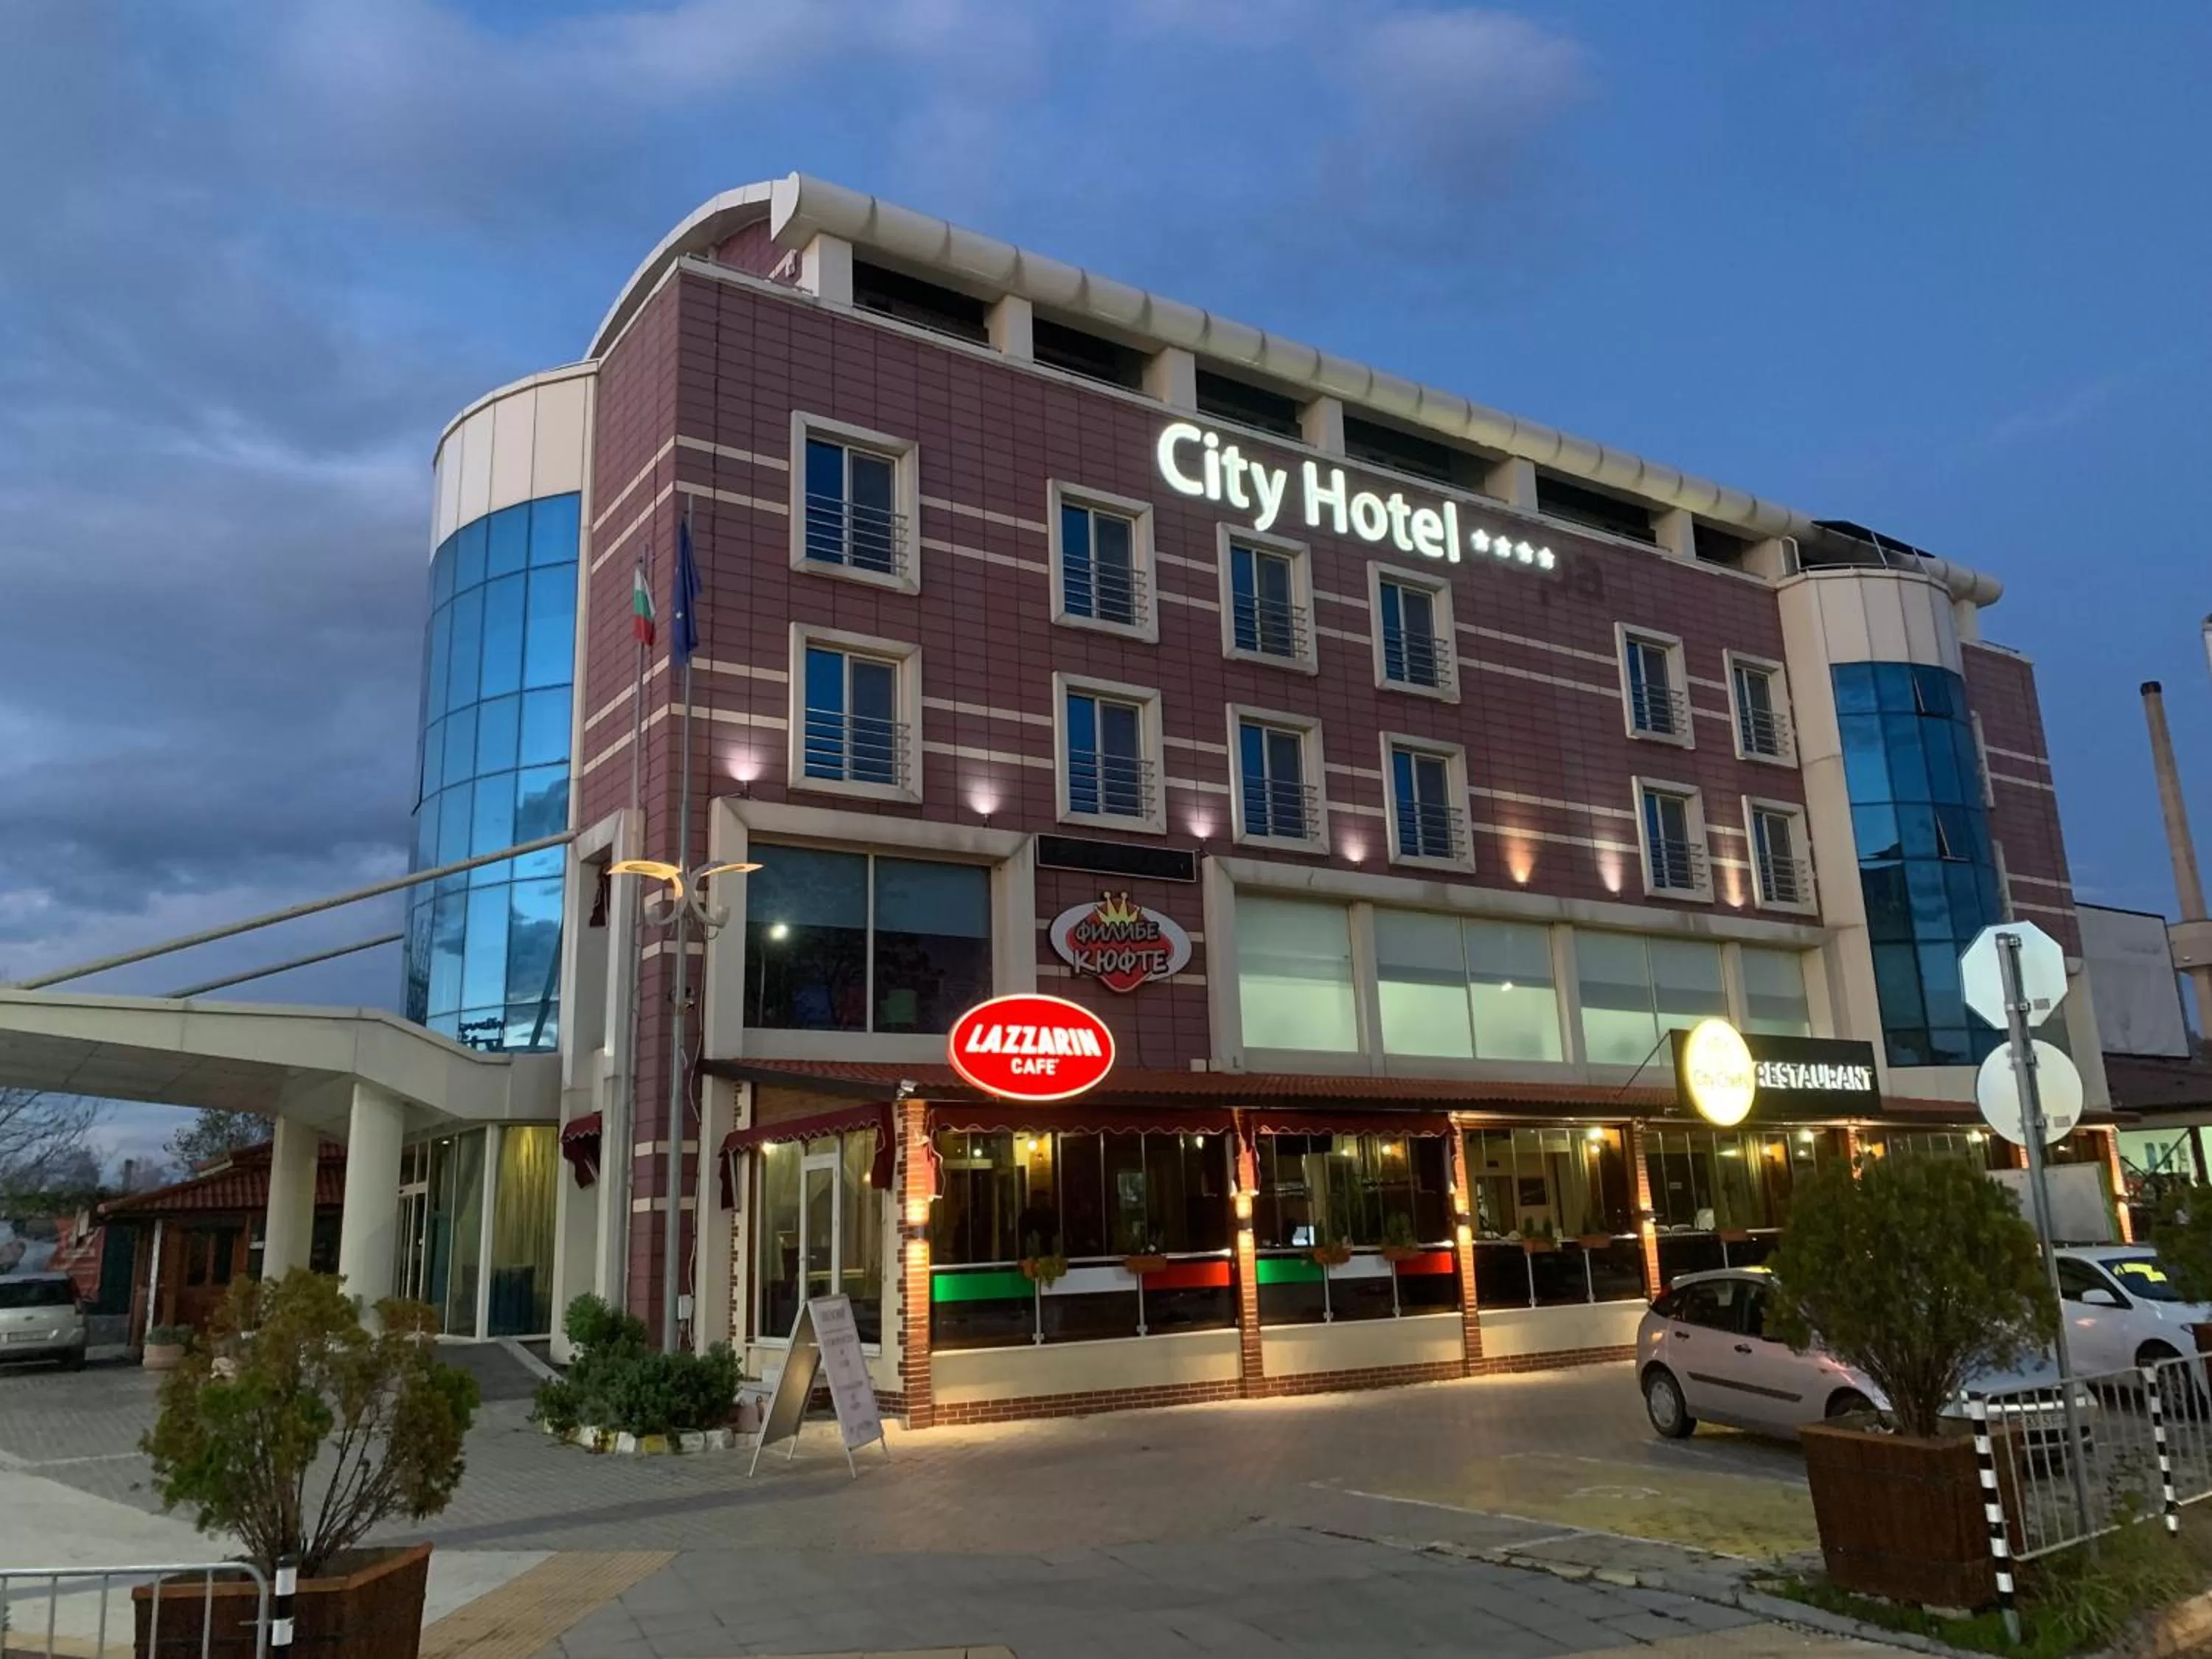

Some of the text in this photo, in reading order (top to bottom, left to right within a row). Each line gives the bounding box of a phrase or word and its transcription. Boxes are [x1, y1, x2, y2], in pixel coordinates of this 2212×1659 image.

[1157, 422, 1461, 563] City Hotel
[1076, 920, 1159, 944] ФИЛИБЕ
[1073, 947, 1169, 974] КЮФТЕ
[964, 1023, 1102, 1057] LAZZARIN
